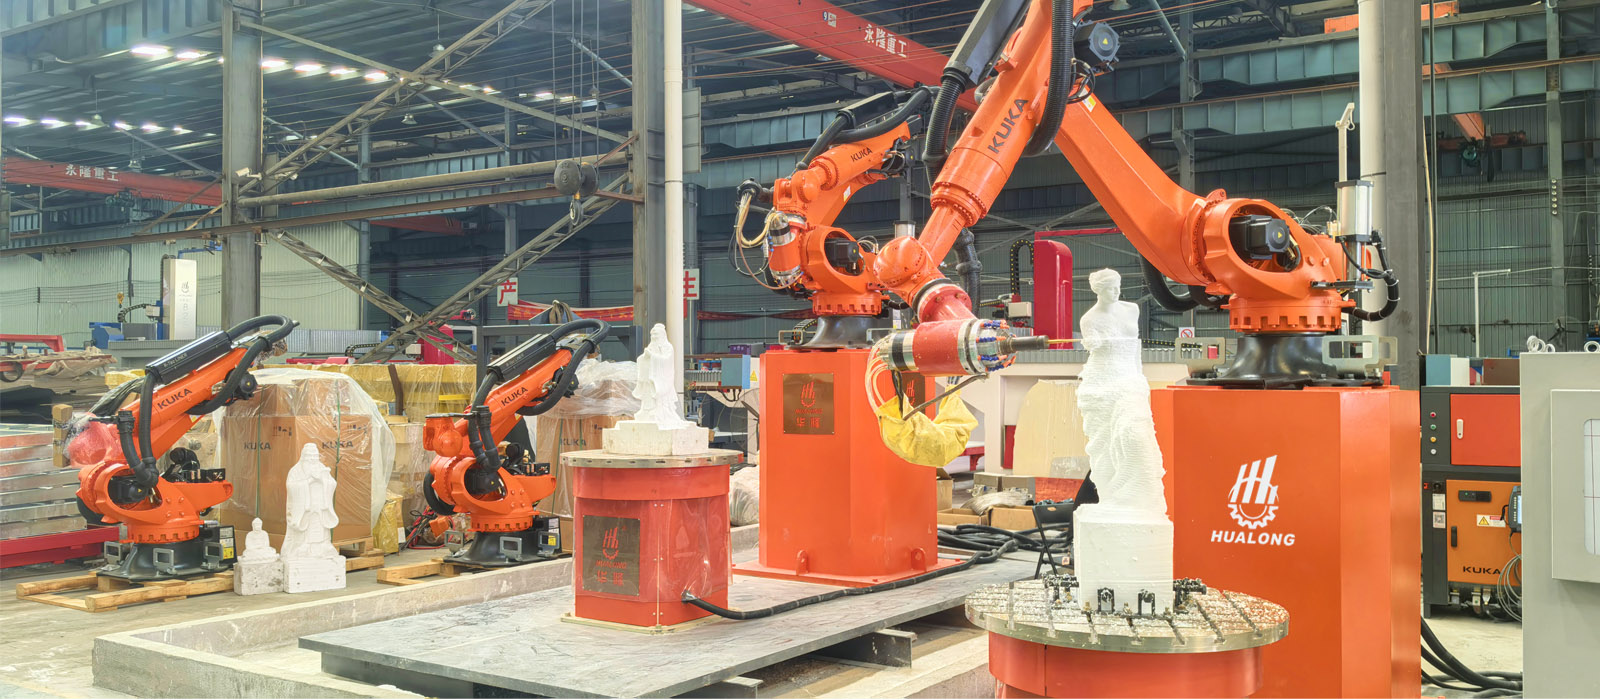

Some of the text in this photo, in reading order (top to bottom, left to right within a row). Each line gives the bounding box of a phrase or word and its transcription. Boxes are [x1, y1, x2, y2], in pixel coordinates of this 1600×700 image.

[864, 23, 907, 58] 永隆重工
[987, 99, 1029, 154] KUKA
[850, 147, 873, 162] KUKA
[65, 164, 119, 181] 永隆重工
[157, 388, 192, 409] KUKA
[501, 387, 528, 406] KUKA
[244, 442, 272, 450] KUKA
[322, 440, 354, 449] KUKA
[1211, 530, 1295, 546] HUALONG
[1463, 566, 1501, 575] KUKA
